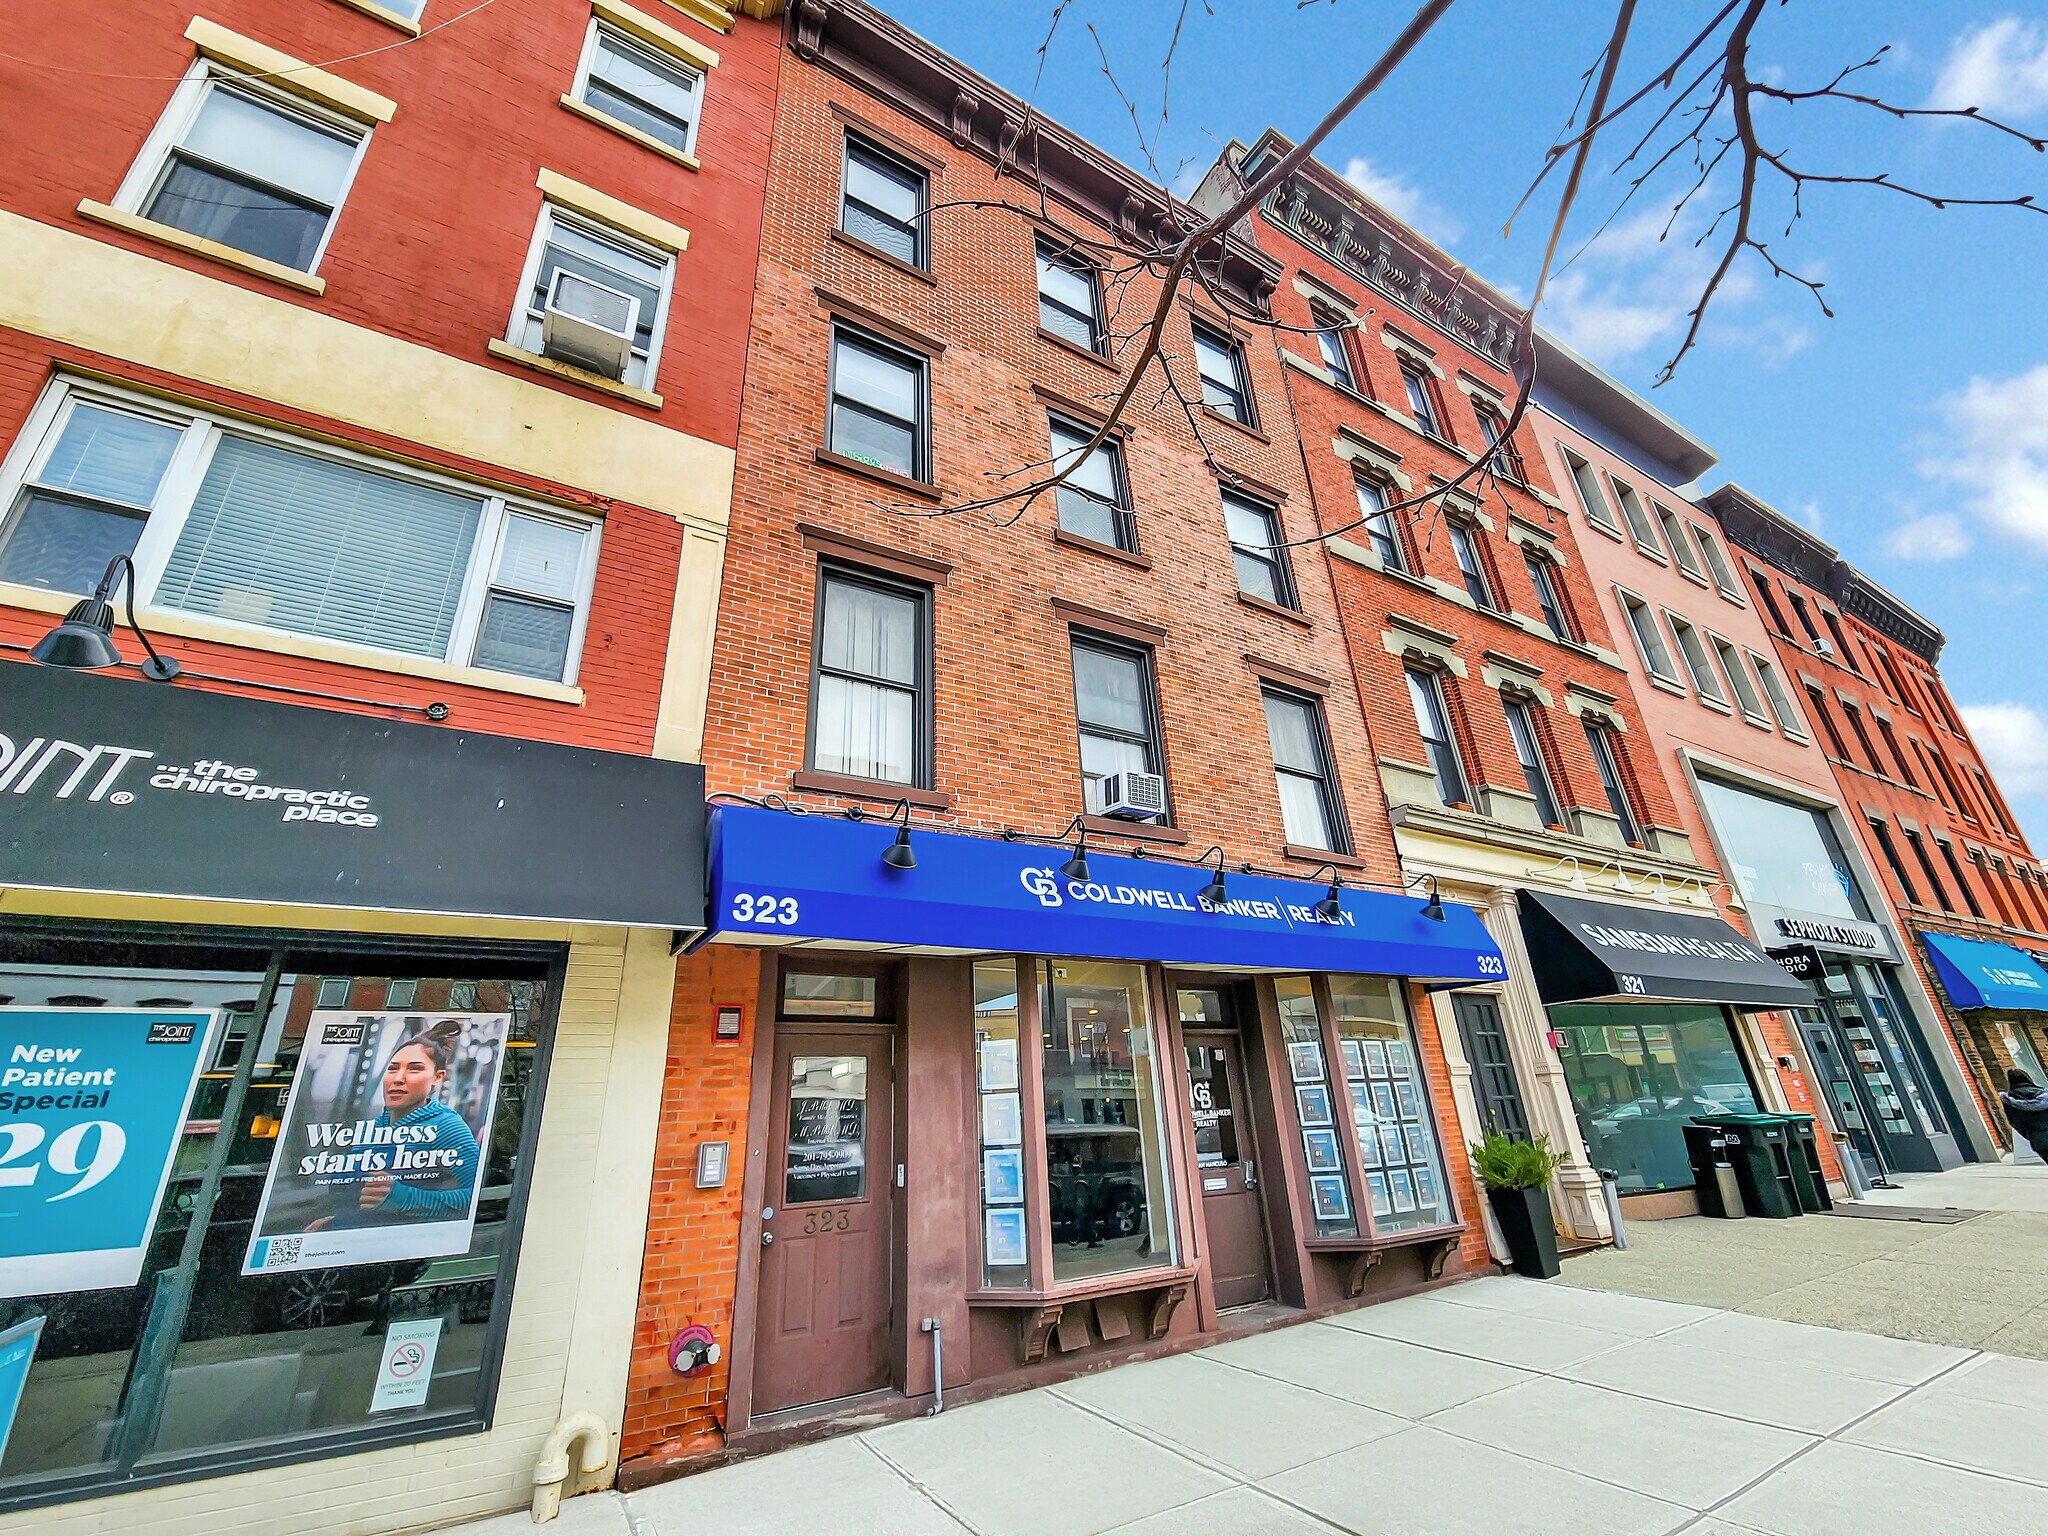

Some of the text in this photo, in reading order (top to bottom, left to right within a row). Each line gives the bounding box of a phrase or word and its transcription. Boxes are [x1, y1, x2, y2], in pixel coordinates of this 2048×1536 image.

[149, 772, 371, 810] chiropractic
[281, 804, 378, 828] place
[732, 893, 799, 925] 323
[1067, 880, 1197, 912] COLDWELL
[1196, 896, 1282, 920] BANKER
[1783, 918, 1879, 949] SEPHORA STUDIO
[1477, 955, 1503, 974] 323
[1775, 954, 1811, 966] HORA
[1784, 964, 1808, 973] DIO
[1622, 975, 1646, 995] 321
[161, 1026, 194, 1037] JOINT
[10, 1044, 82, 1063] New
[1, 1067, 117, 1087] Patient
[0, 1089, 111, 1114] Special
[1196, 1119, 1217, 1128] REALTY
[305, 1119, 438, 1148] Wellness
[297, 1144, 464, 1176] starts here.
[1206, 1160, 1228, 1169] MANCUSO
[332, 1177, 355, 1185] RELIEF
[803, 1209, 850, 1234] 323
[304, 1249, 346, 1258] thejoint.com
[404, 1331, 435, 1341] SMOKING
[380, 1382, 402, 1390] WITHIN
